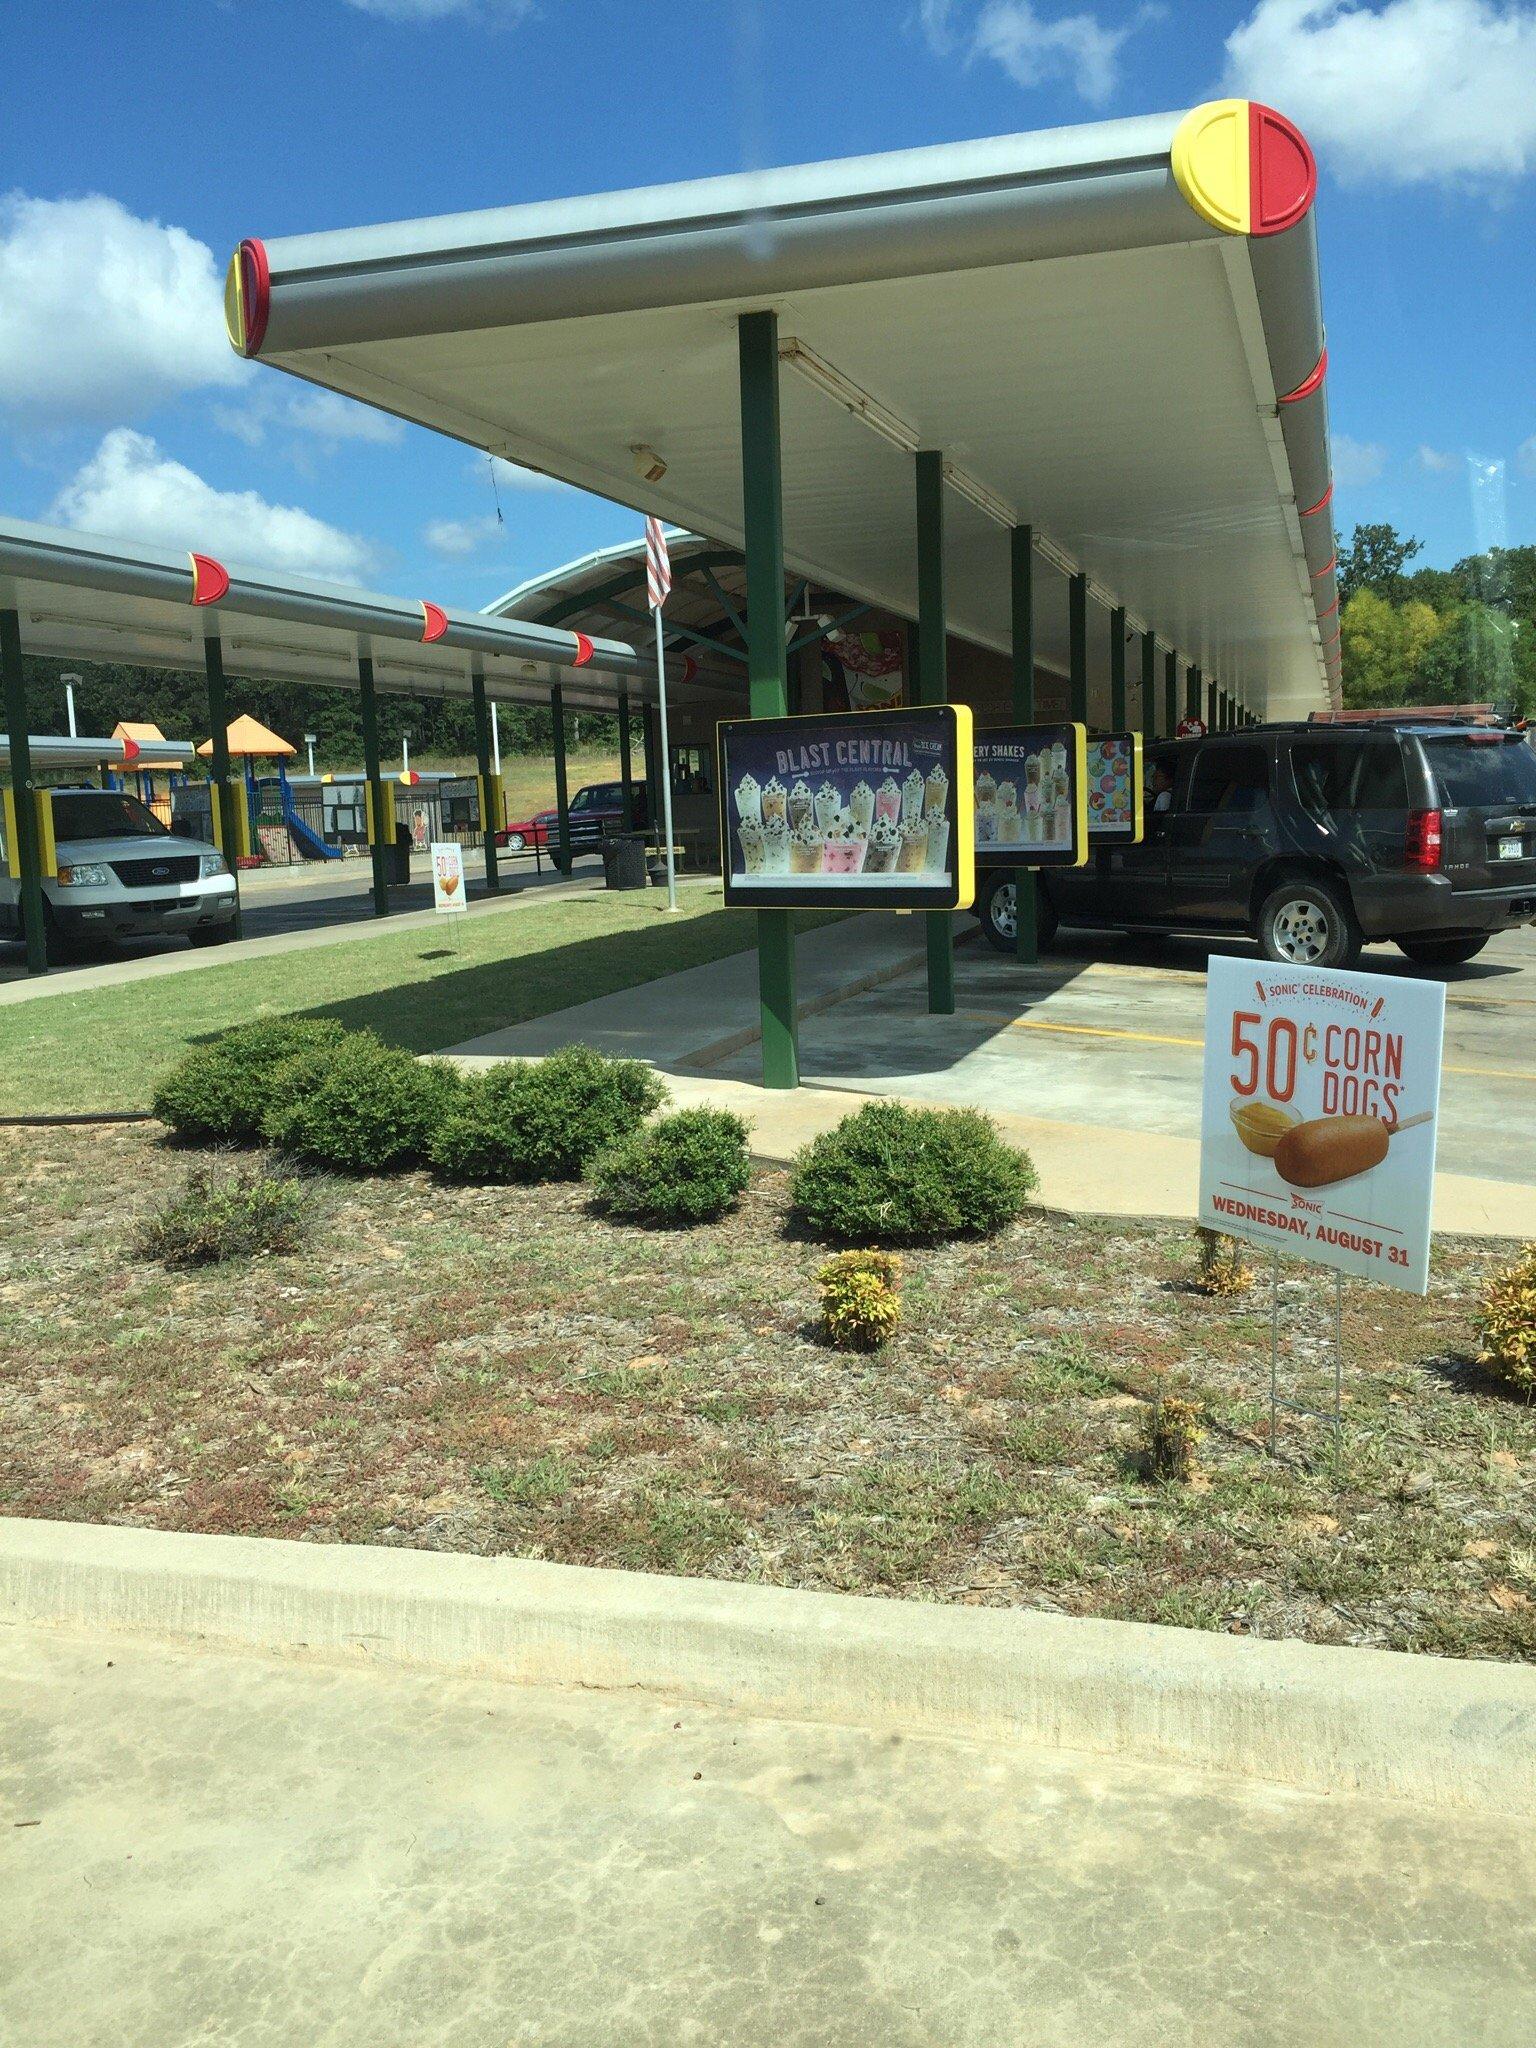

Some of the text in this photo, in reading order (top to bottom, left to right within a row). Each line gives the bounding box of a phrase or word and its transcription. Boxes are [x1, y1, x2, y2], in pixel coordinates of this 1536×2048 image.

[776, 739, 913, 775] BLAST CENTRAL
[991, 744, 1025, 759] SHAKES
[1443, 863, 1470, 871] TAHOE
[1269, 984, 1369, 1010] SONIC CELEBRATION
[1324, 1024, 1403, 1080] CORN
[1291, 1196, 1323, 1214] SONIC
[1211, 1194, 1311, 1241] WEDNESDAY,
[1315, 1225, 1383, 1259] AUGUST
[1387, 1245, 1410, 1267] 31
